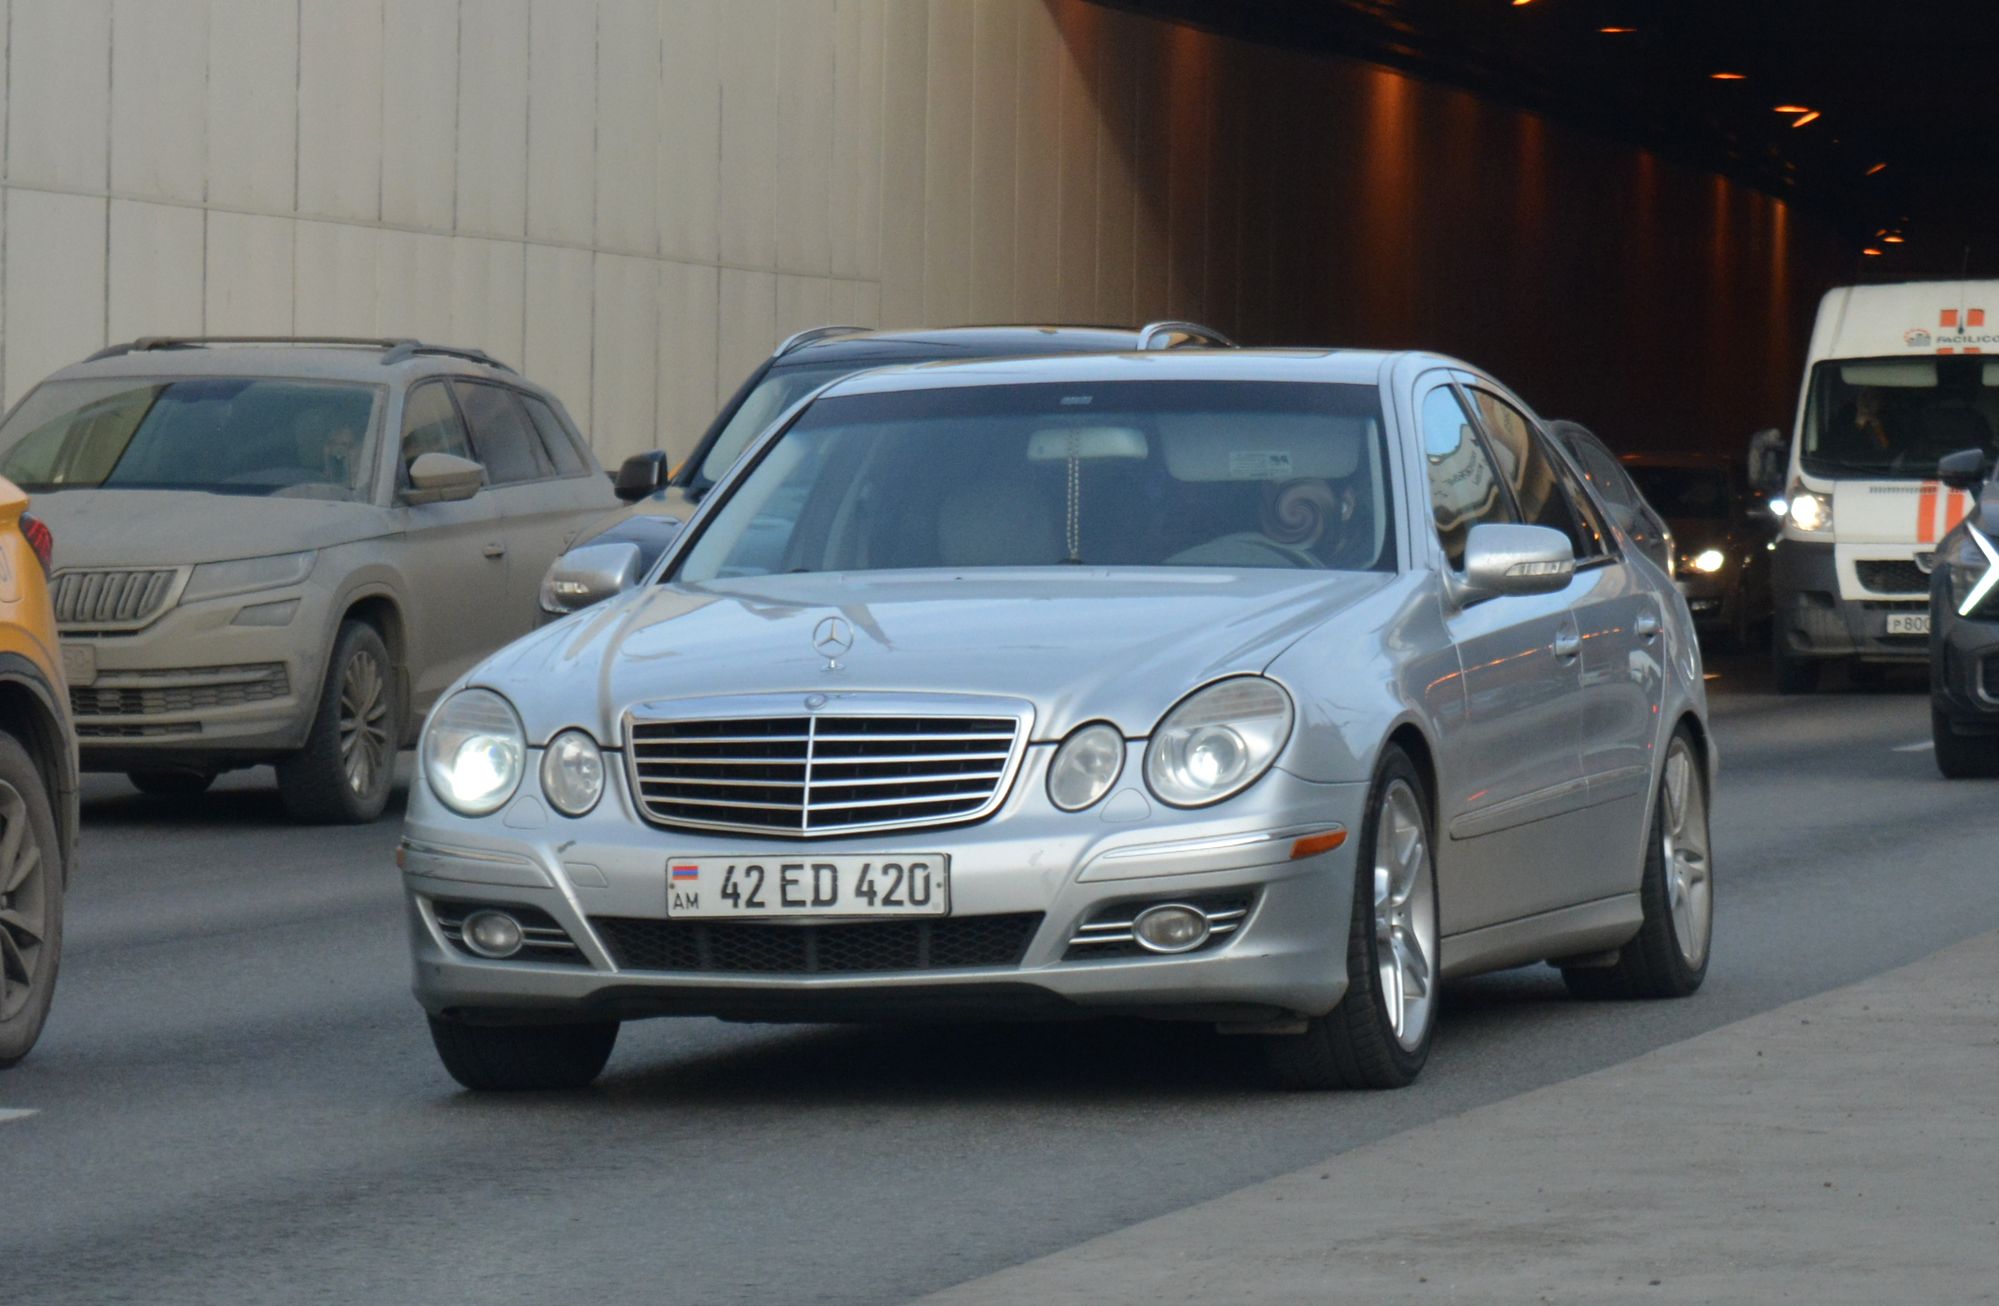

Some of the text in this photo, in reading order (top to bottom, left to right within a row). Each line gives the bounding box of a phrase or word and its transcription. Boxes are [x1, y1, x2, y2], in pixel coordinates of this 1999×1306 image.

[673, 892, 699, 911] AM
[721, 862, 932, 909] 42 ED 420
